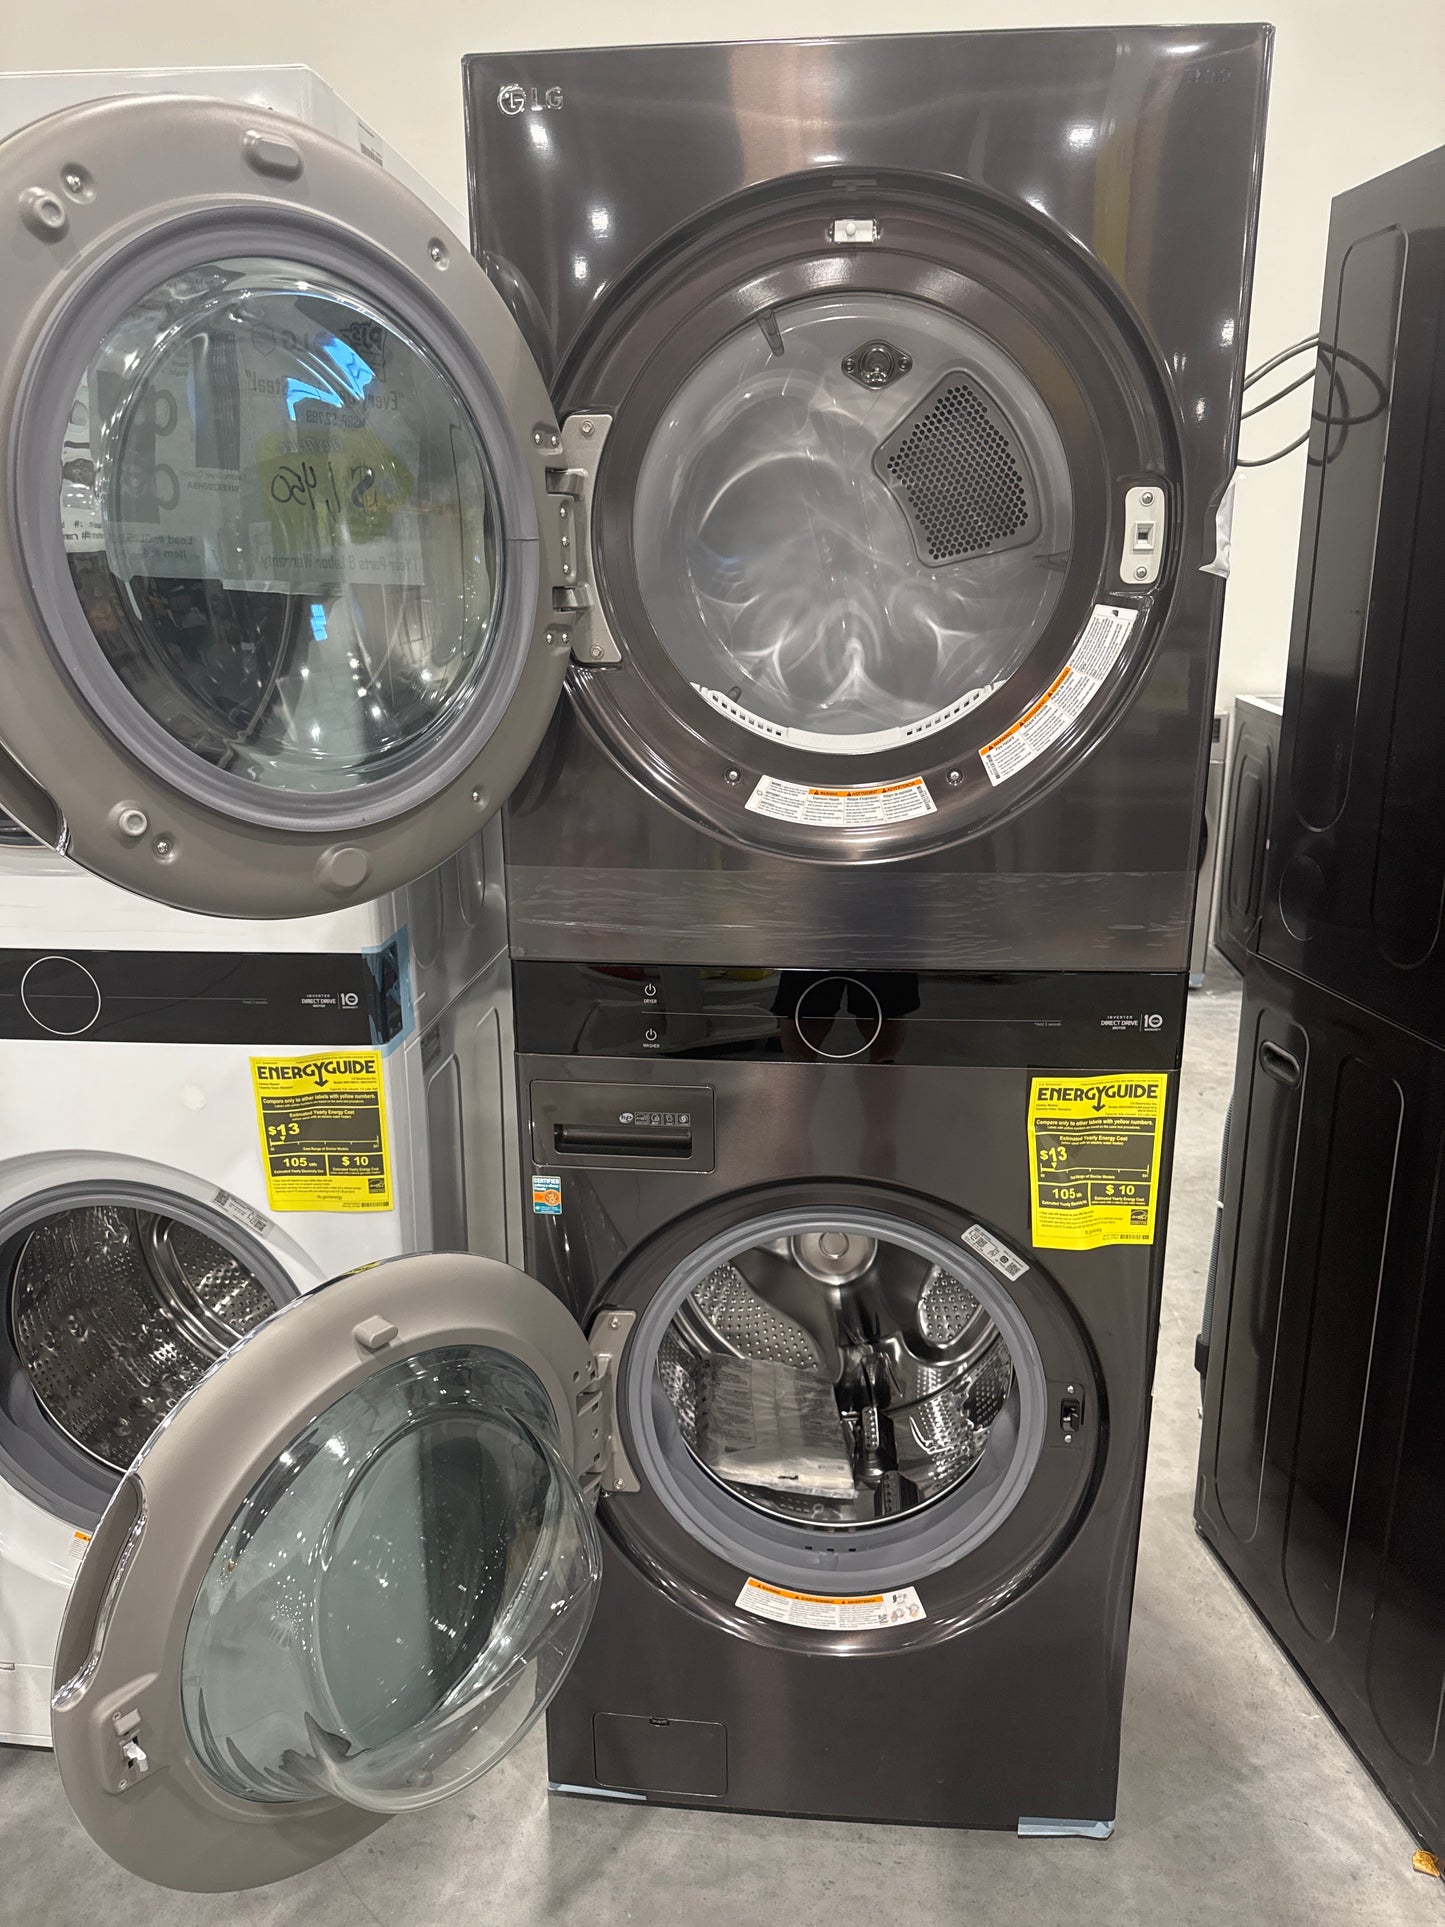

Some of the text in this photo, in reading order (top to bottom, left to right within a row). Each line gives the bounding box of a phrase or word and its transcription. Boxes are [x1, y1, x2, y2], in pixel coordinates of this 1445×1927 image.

[530, 86, 563, 111] LG
[341, 993, 359, 1006] 10
[1144, 1014, 1163, 1028] 10
[257, 1059, 376, 1084] ENERGYGUIDE
[1037, 1084, 1159, 1107] ENERGYGUIDE
[268, 1123, 300, 1136] $13
[1040, 1147, 1067, 1162] $13
[283, 1157, 308, 1167] 105
[1052, 1188, 1075, 1199] 105
